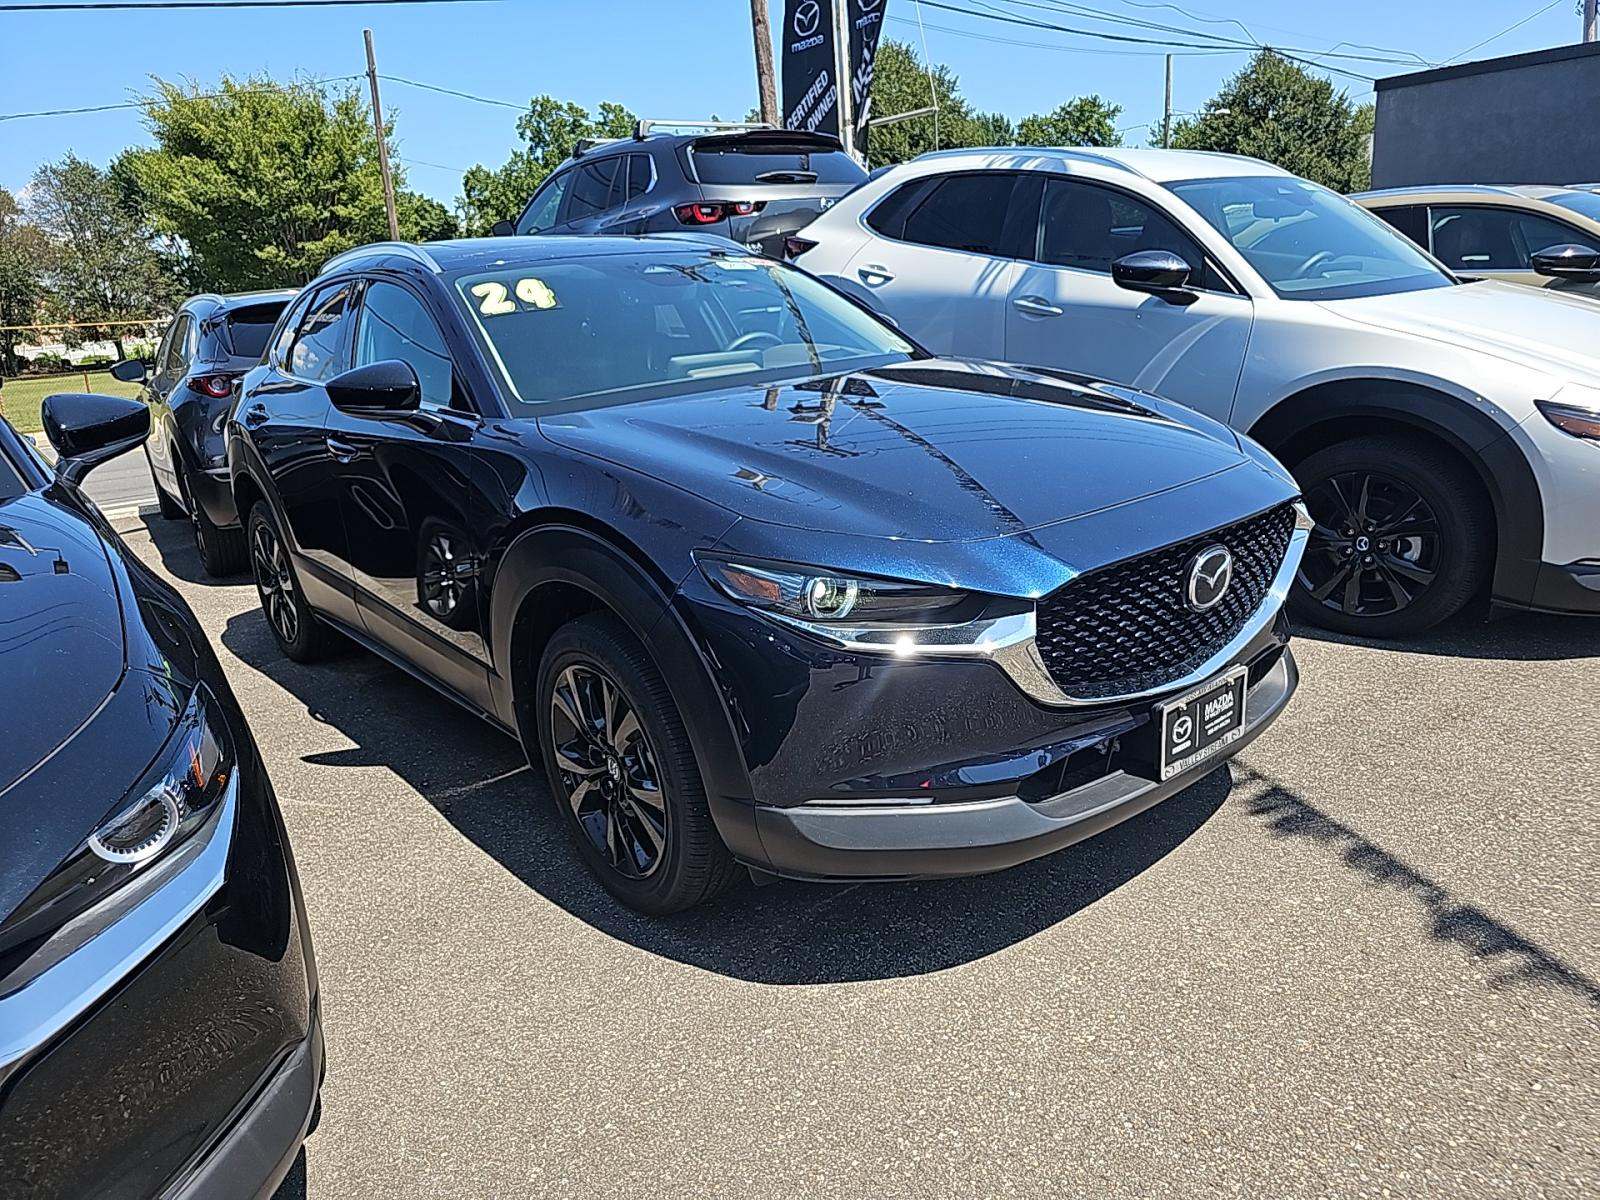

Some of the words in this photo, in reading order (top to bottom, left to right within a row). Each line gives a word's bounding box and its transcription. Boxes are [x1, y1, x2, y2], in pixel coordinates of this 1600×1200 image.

[791, 34, 824, 53] mazda
[786, 70, 828, 130] CERTIFIED
[807, 85, 836, 132] OWNED
[470, 278, 557, 315] 24
[1204, 690, 1234, 716] MAZDA
